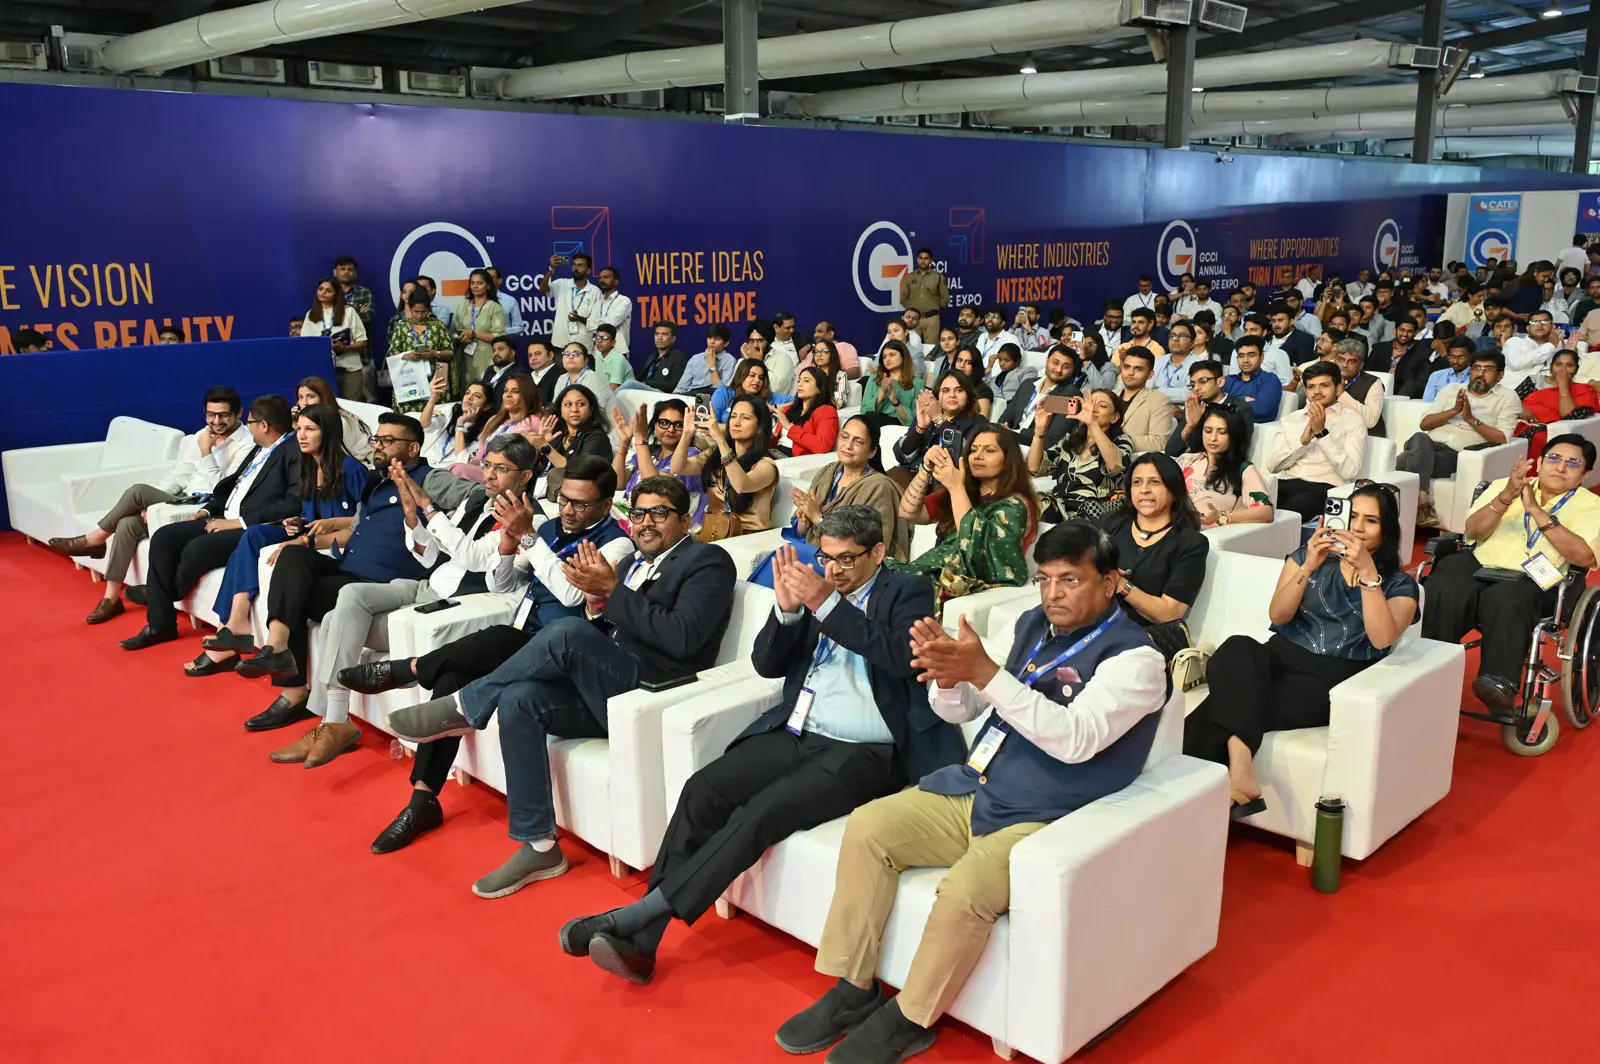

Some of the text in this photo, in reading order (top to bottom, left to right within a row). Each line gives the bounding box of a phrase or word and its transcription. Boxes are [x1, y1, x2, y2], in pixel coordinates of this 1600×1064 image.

[996, 241, 1110, 270] WHERE INDUSTRIES
[1199, 251, 1219, 263] GCCI
[1250, 237, 1340, 260] WHERE OPPORTUNITIES
[635, 250, 764, 285] WHERE IDEAS
[1198, 265, 1227, 277] ANNUAL
[1248, 266, 1271, 287] TURN
[29, 262, 154, 309] VISION
[996, 275, 1064, 304] INTERSECT
[1221, 278, 1239, 290] EXPO
[637, 291, 757, 328] TAKE SHAPE
[956, 293, 982, 307] EXPO
